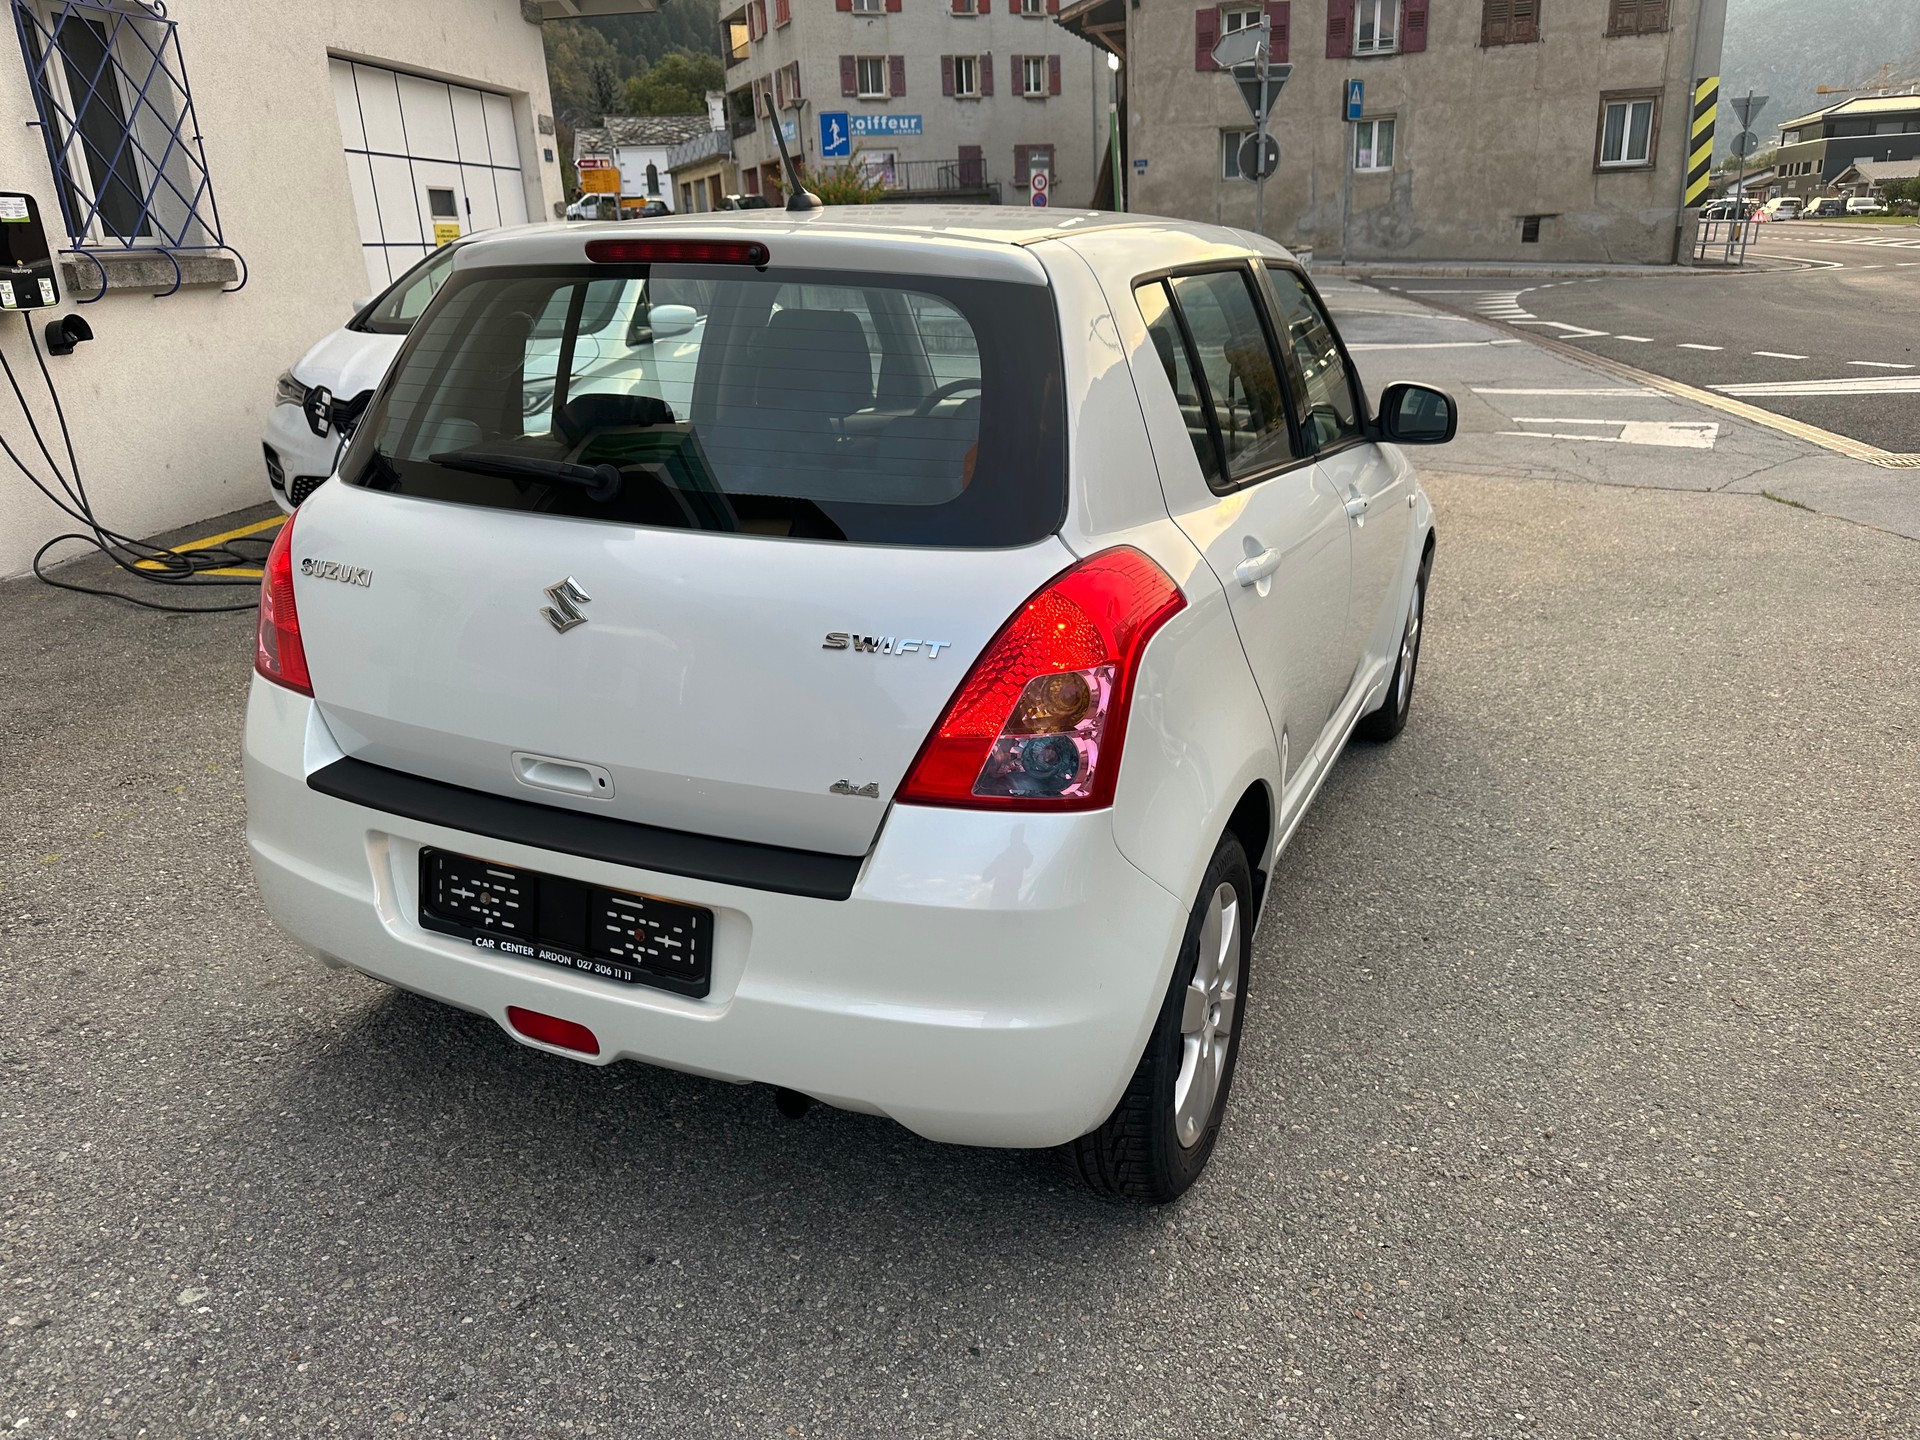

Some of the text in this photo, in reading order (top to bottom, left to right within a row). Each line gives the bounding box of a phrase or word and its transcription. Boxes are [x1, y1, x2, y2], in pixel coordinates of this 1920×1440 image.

[300, 558, 373, 588] SUZUKI
[821, 631, 952, 660] SWIFT
[475, 937, 632, 981] CAR CENTER ARDON 027 306 11 11
